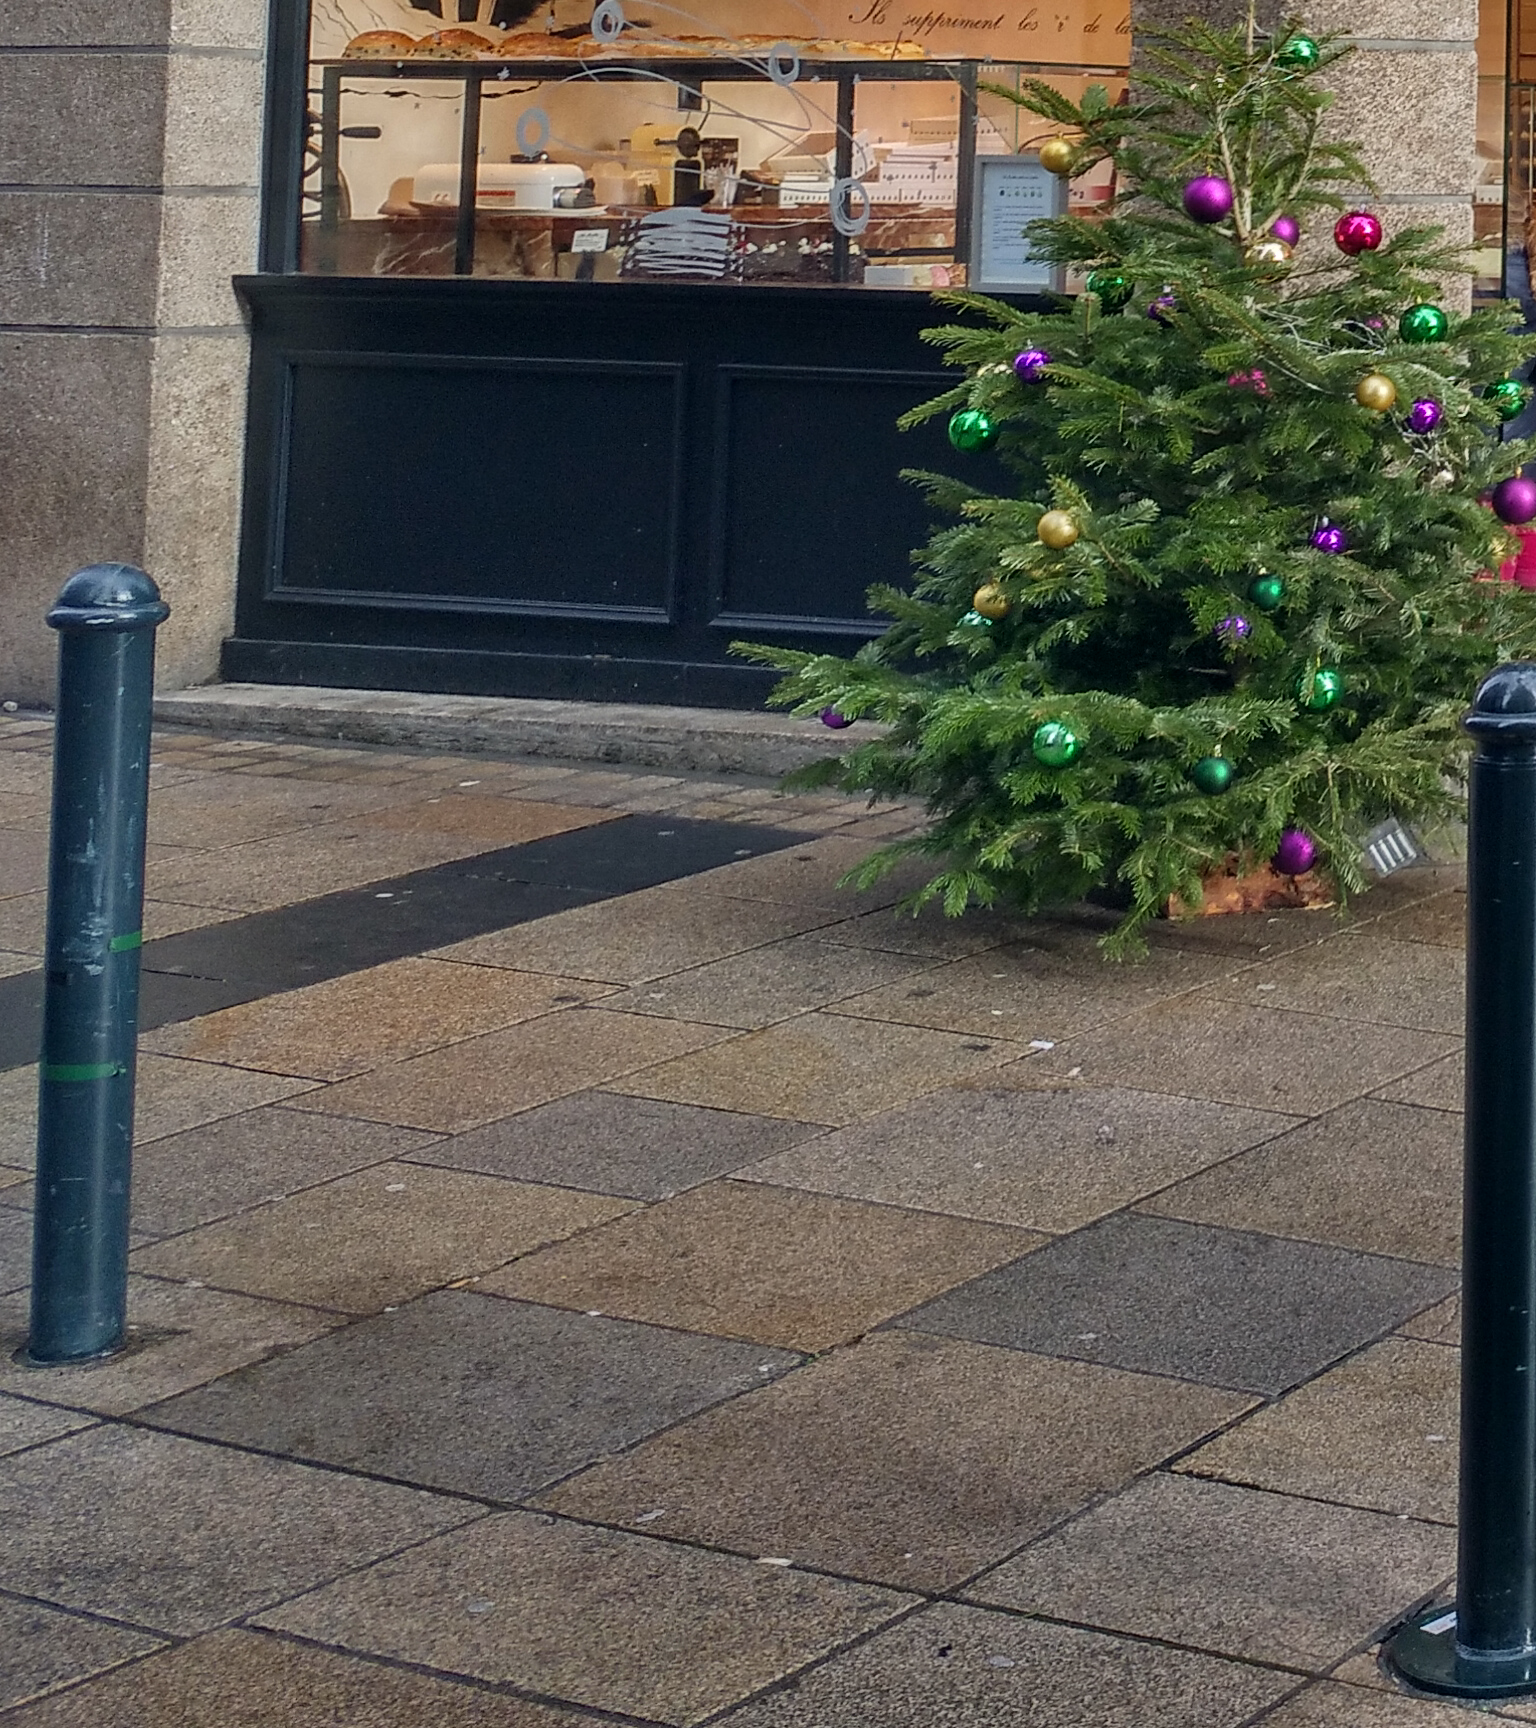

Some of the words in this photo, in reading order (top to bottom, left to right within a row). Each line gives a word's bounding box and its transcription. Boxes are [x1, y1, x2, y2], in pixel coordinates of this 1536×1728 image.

[901, 10, 1002, 37] suppriment
[1017, 8, 1039, 32] les
[1083, 13, 1103, 34] de
